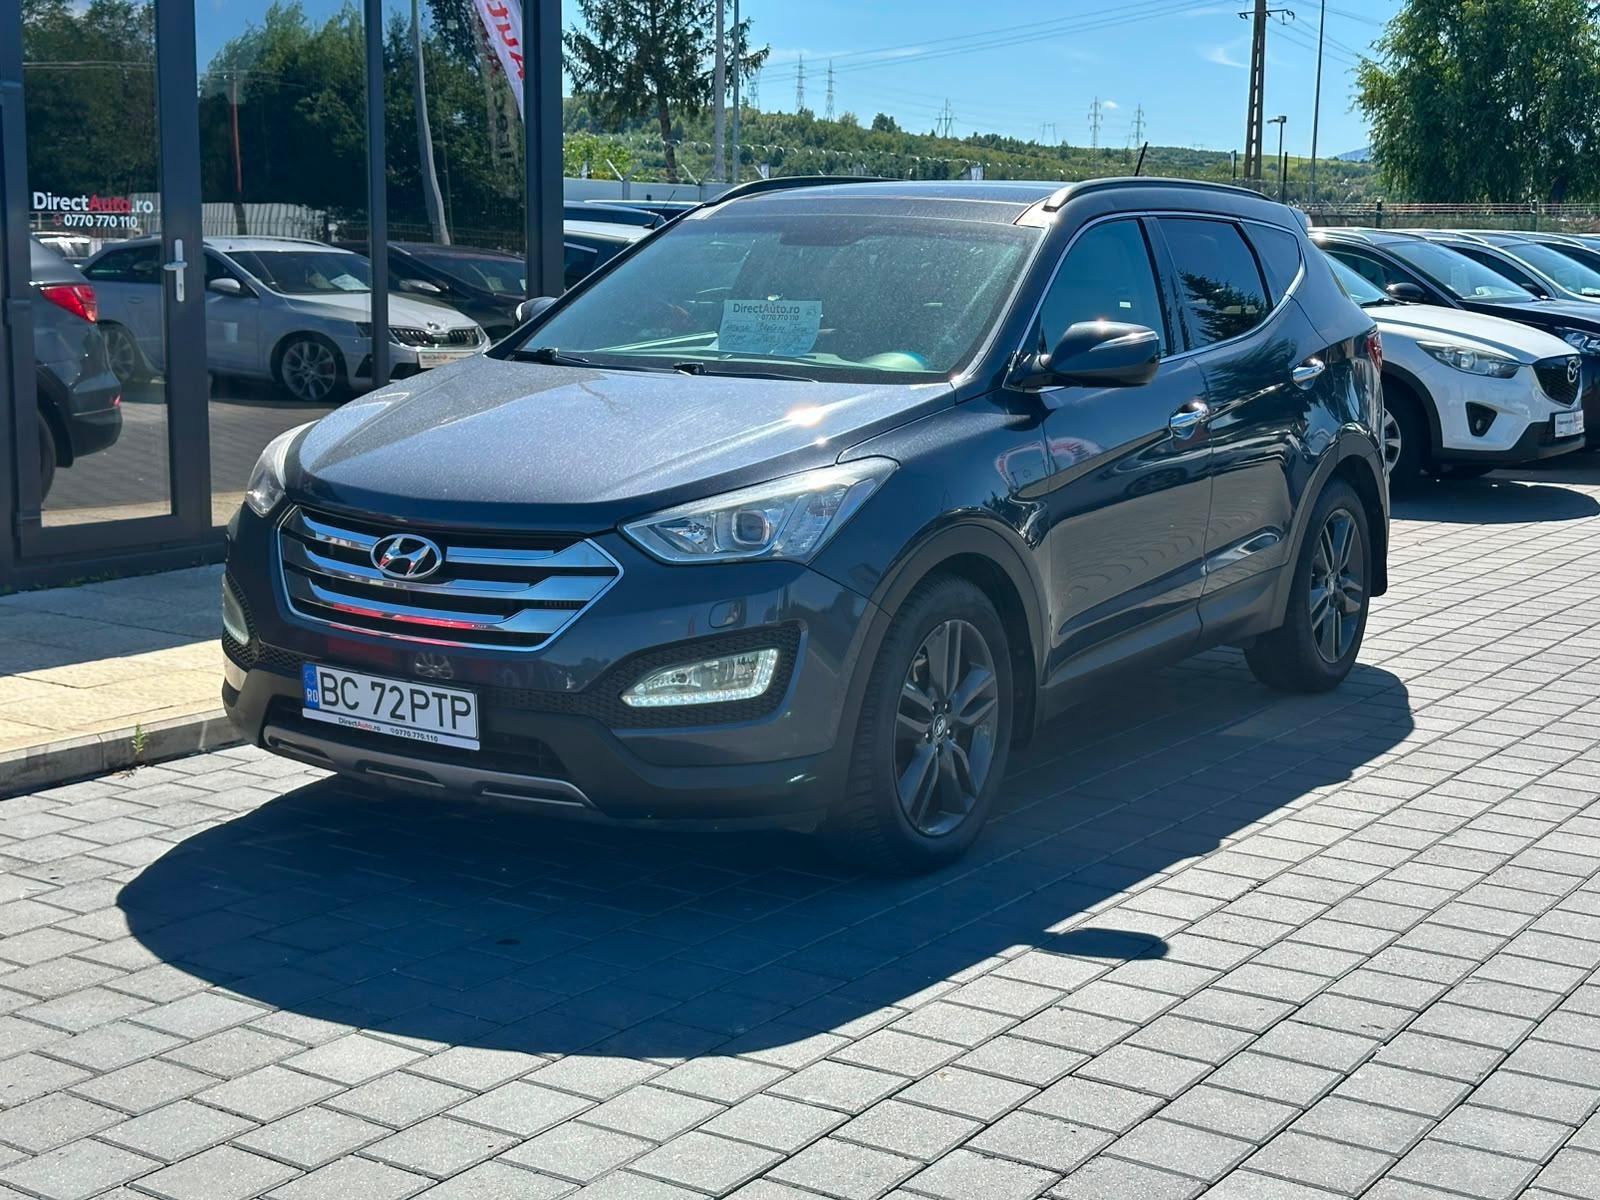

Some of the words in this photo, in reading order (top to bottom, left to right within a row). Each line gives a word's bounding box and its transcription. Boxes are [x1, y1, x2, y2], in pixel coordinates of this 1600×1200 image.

[32, 191, 154, 214] DirectAuto.ro
[64, 214, 93, 227] 0770
[95, 215, 117, 228] 770
[119, 216, 138, 229] 110
[733, 303, 800, 315] DirectAuto.ro
[306, 689, 319, 704] RO
[319, 671, 360, 711] BC
[338, 716, 381, 732] DirectAuto.ro
